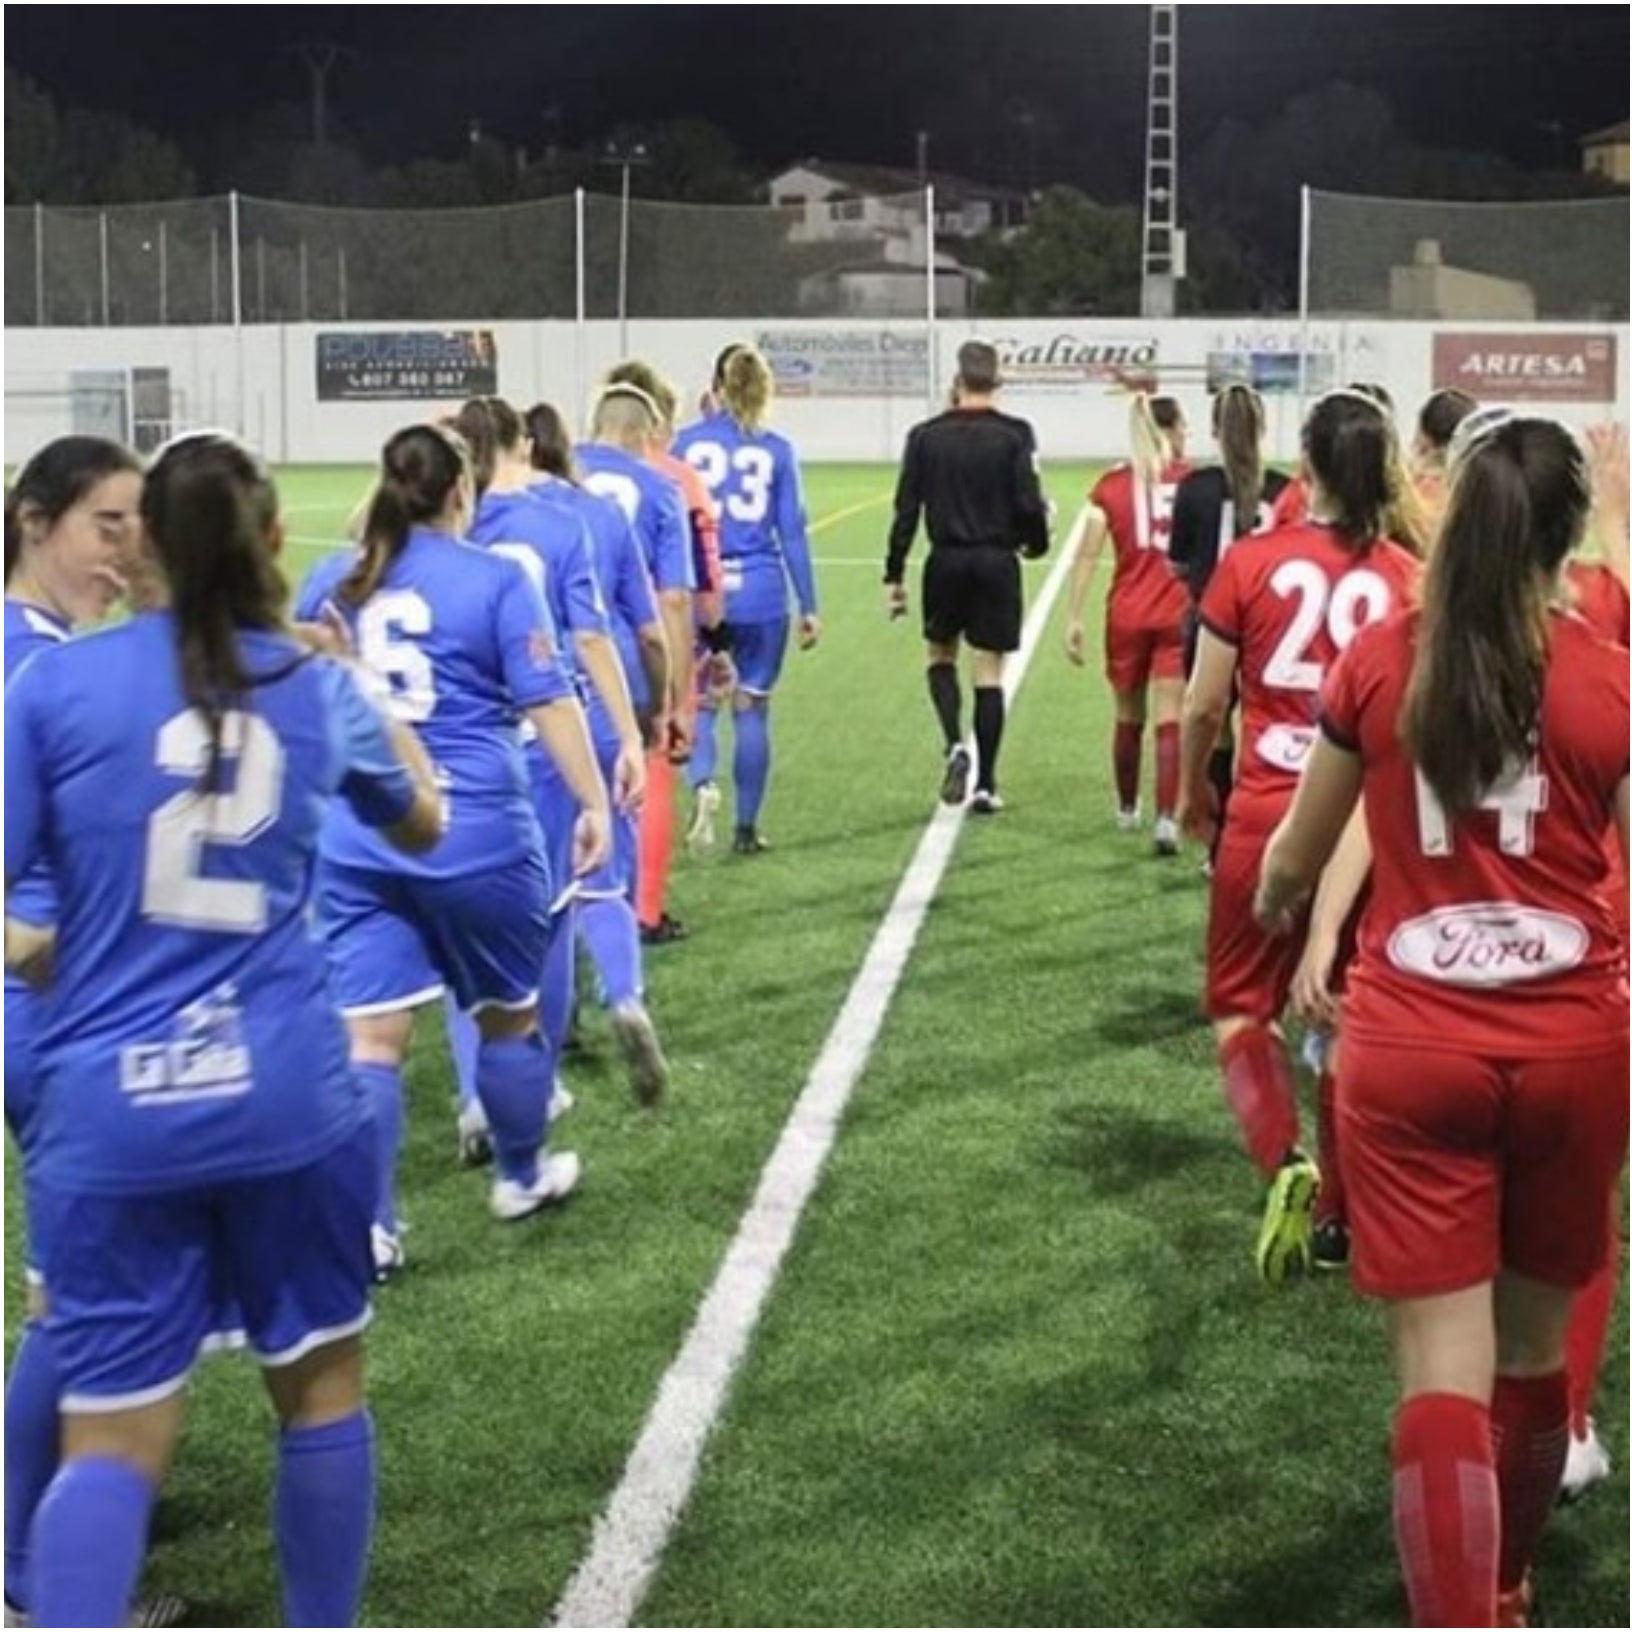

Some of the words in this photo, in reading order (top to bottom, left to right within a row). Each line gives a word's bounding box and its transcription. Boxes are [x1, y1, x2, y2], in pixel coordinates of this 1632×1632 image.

[1459, 353, 1585, 376] ARTESA
[686, 441, 774, 522] 23
[358, 587, 437, 723] 6
[140, 707, 287, 934] 2
[1432, 916, 1548, 968] Ford
